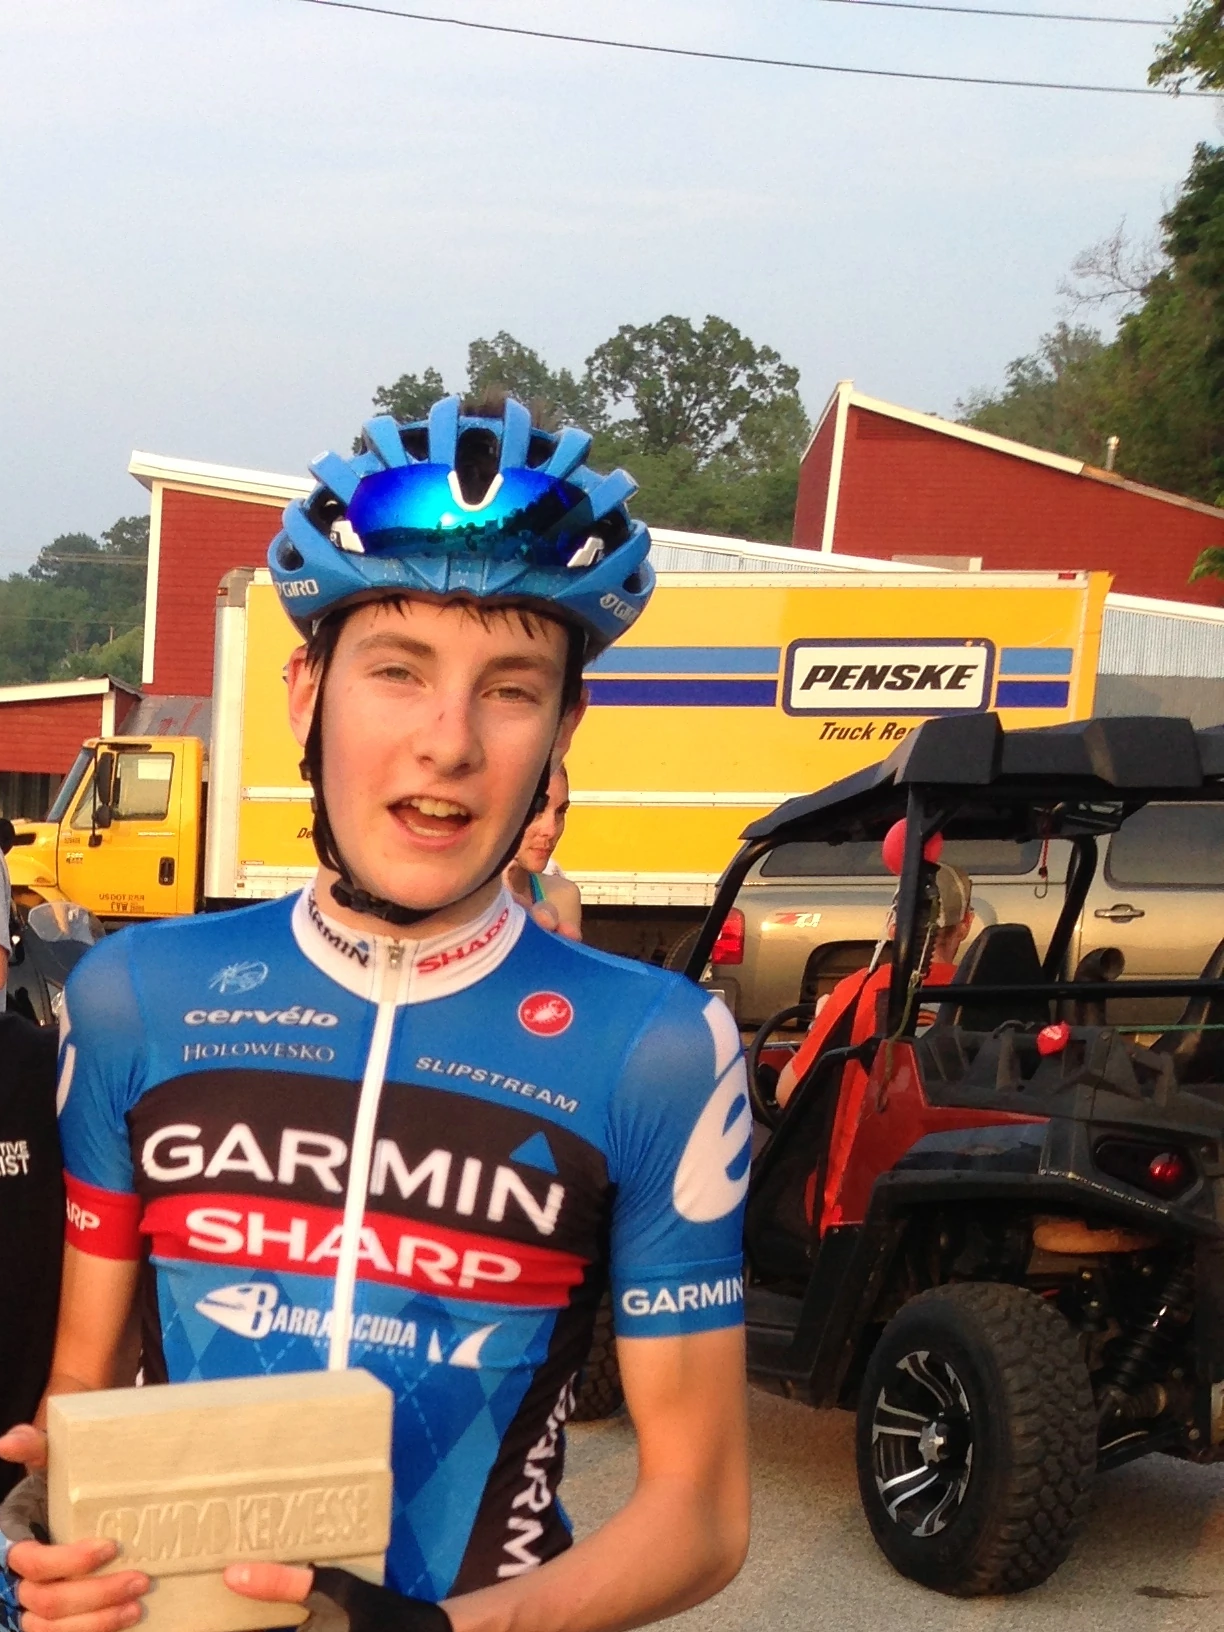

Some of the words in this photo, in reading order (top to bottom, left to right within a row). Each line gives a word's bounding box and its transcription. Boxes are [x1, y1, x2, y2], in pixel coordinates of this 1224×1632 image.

[281, 578, 320, 598] GIRO
[799, 664, 979, 691] PENSKE
[818, 721, 877, 741] Truck
[307, 888, 371, 969] ARMIN
[182, 1005, 339, 1028] cervélo
[182, 1041, 336, 1064] HOLOWESKO
[415, 1055, 579, 1114] SLIPSTREAM
[141, 1122, 566, 1236] GARMIN
[184, 1207, 522, 1289] SHARP
[621, 1275, 744, 1317] GARMIN
